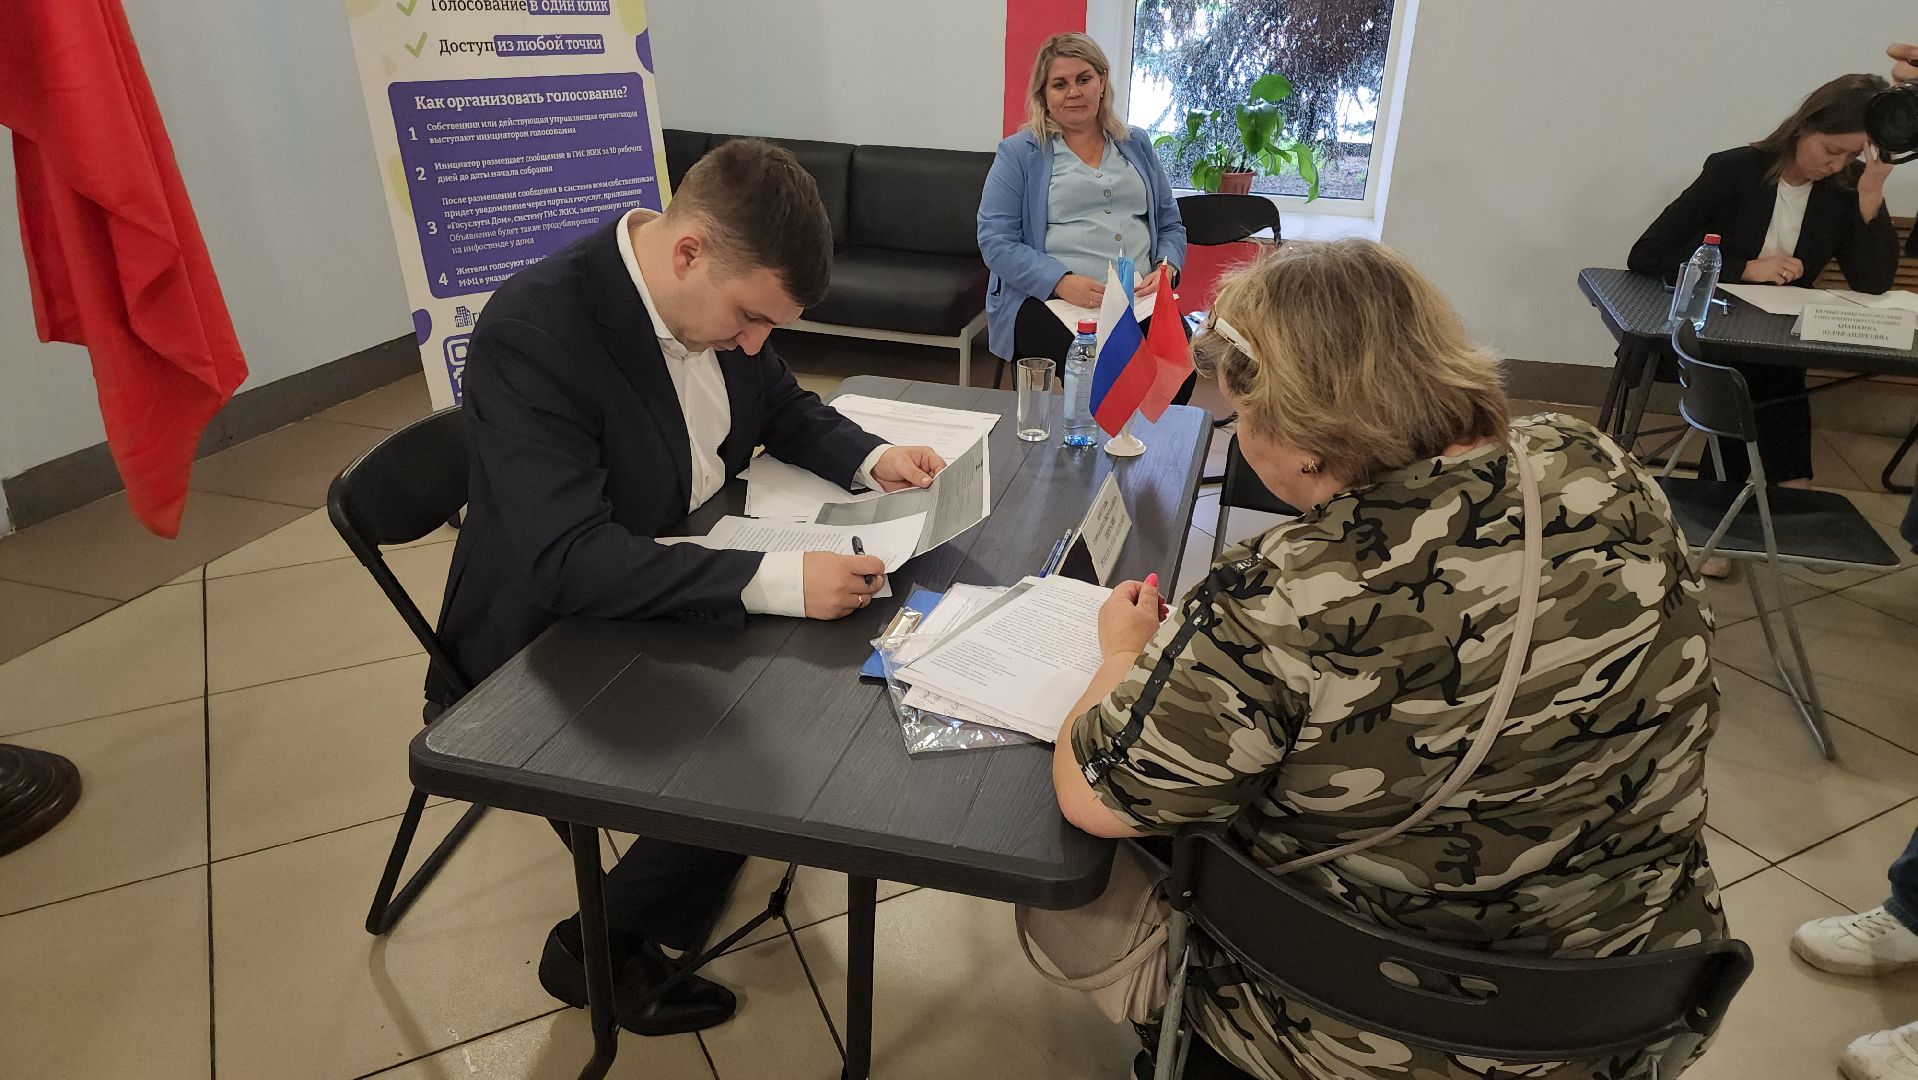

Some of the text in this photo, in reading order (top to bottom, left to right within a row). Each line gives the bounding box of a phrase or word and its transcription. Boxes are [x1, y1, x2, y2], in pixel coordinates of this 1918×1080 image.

[431, 0, 609, 13] Голосование в один клик
[439, 35, 603, 56] Доступ из любой точки
[414, 86, 628, 112] Как организовать голосование?
[426, 122, 480, 131] Собственник
[481, 120, 497, 128] или
[499, 115, 549, 128] действующая
[408, 127, 418, 141] 1
[429, 127, 576, 145] выступают инициатором голосования
[434, 160, 480, 171] Инициатор
[482, 155, 524, 168] размещает
[526, 152, 566, 163] сообщение
[572, 150, 586, 158] ГИС
[609, 146, 617, 154] 10
[415, 166, 427, 181] 2
[437, 165, 553, 185] дней до даты начала собрания
[442, 197, 467, 206] После
[467, 191, 517, 205] размещения
[518, 186, 557, 198] сообщения
[564, 183, 592, 193] системе
[444, 209, 474, 219] придет
[475, 203, 526, 217] уведомление
[526, 199, 547, 209] через
[547, 196, 573, 207] портал
[514, 210, 543, 222] систему
[544, 208, 558, 218] ГИС
[426, 221, 438, 235] 3
[449, 230, 497, 242] Объявление
[497, 226, 519, 237] будет
[520, 224, 541, 234] также
[451, 246, 462, 255] на
[463, 241, 510, 254] инфостенде
[515, 237, 535, 247] дома
[456, 264, 488, 275] Жители
[489, 259, 525, 271] голосуют
[438, 272, 449, 286] 4
[458, 277, 481, 288] МФЦ
